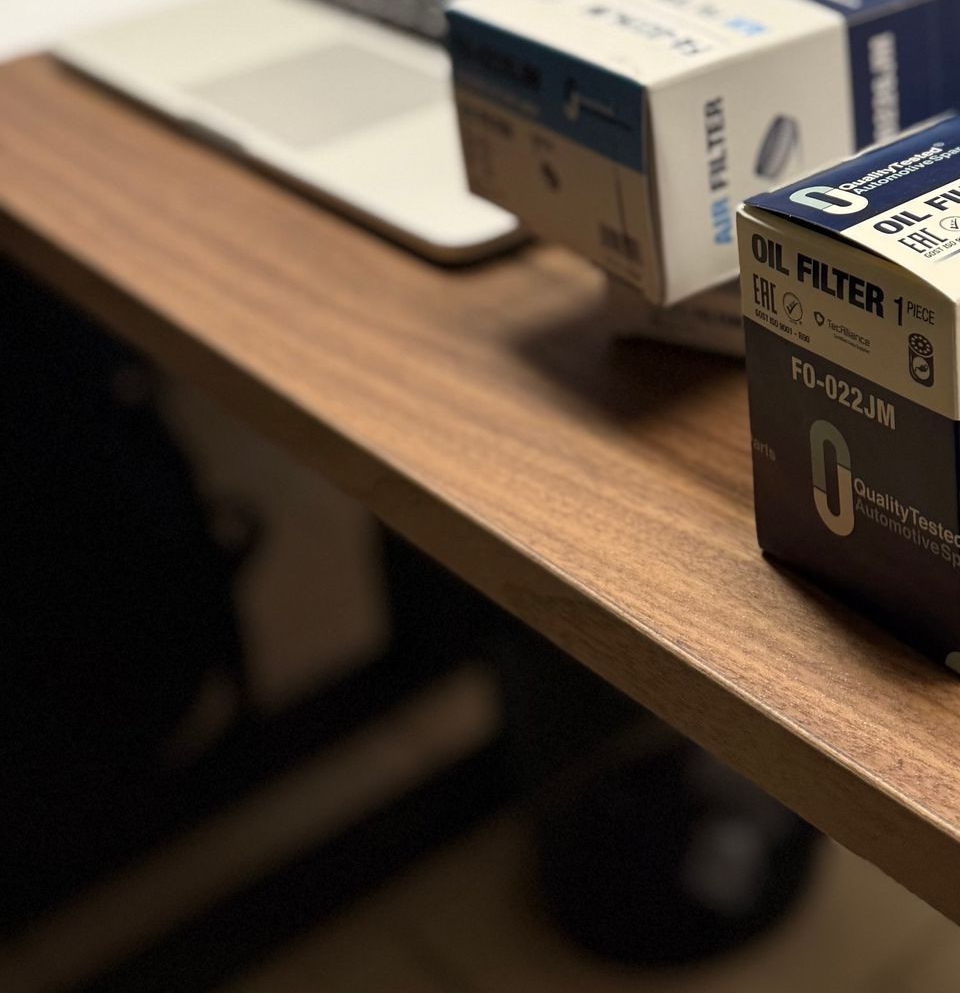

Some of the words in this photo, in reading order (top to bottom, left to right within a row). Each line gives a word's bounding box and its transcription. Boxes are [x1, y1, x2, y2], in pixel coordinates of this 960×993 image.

[704, 95, 728, 192] FILTER
[711, 198, 733, 245] AIR
[873, 210, 934, 235] OIL
[923, 247, 942, 258] GOST
[942, 240, 956, 252] ISO
[751, 233, 789, 276] OIL
[797, 252, 884, 318] FILTER
[894, 296, 903, 327] 1
[907, 300, 935, 325] PIECE
